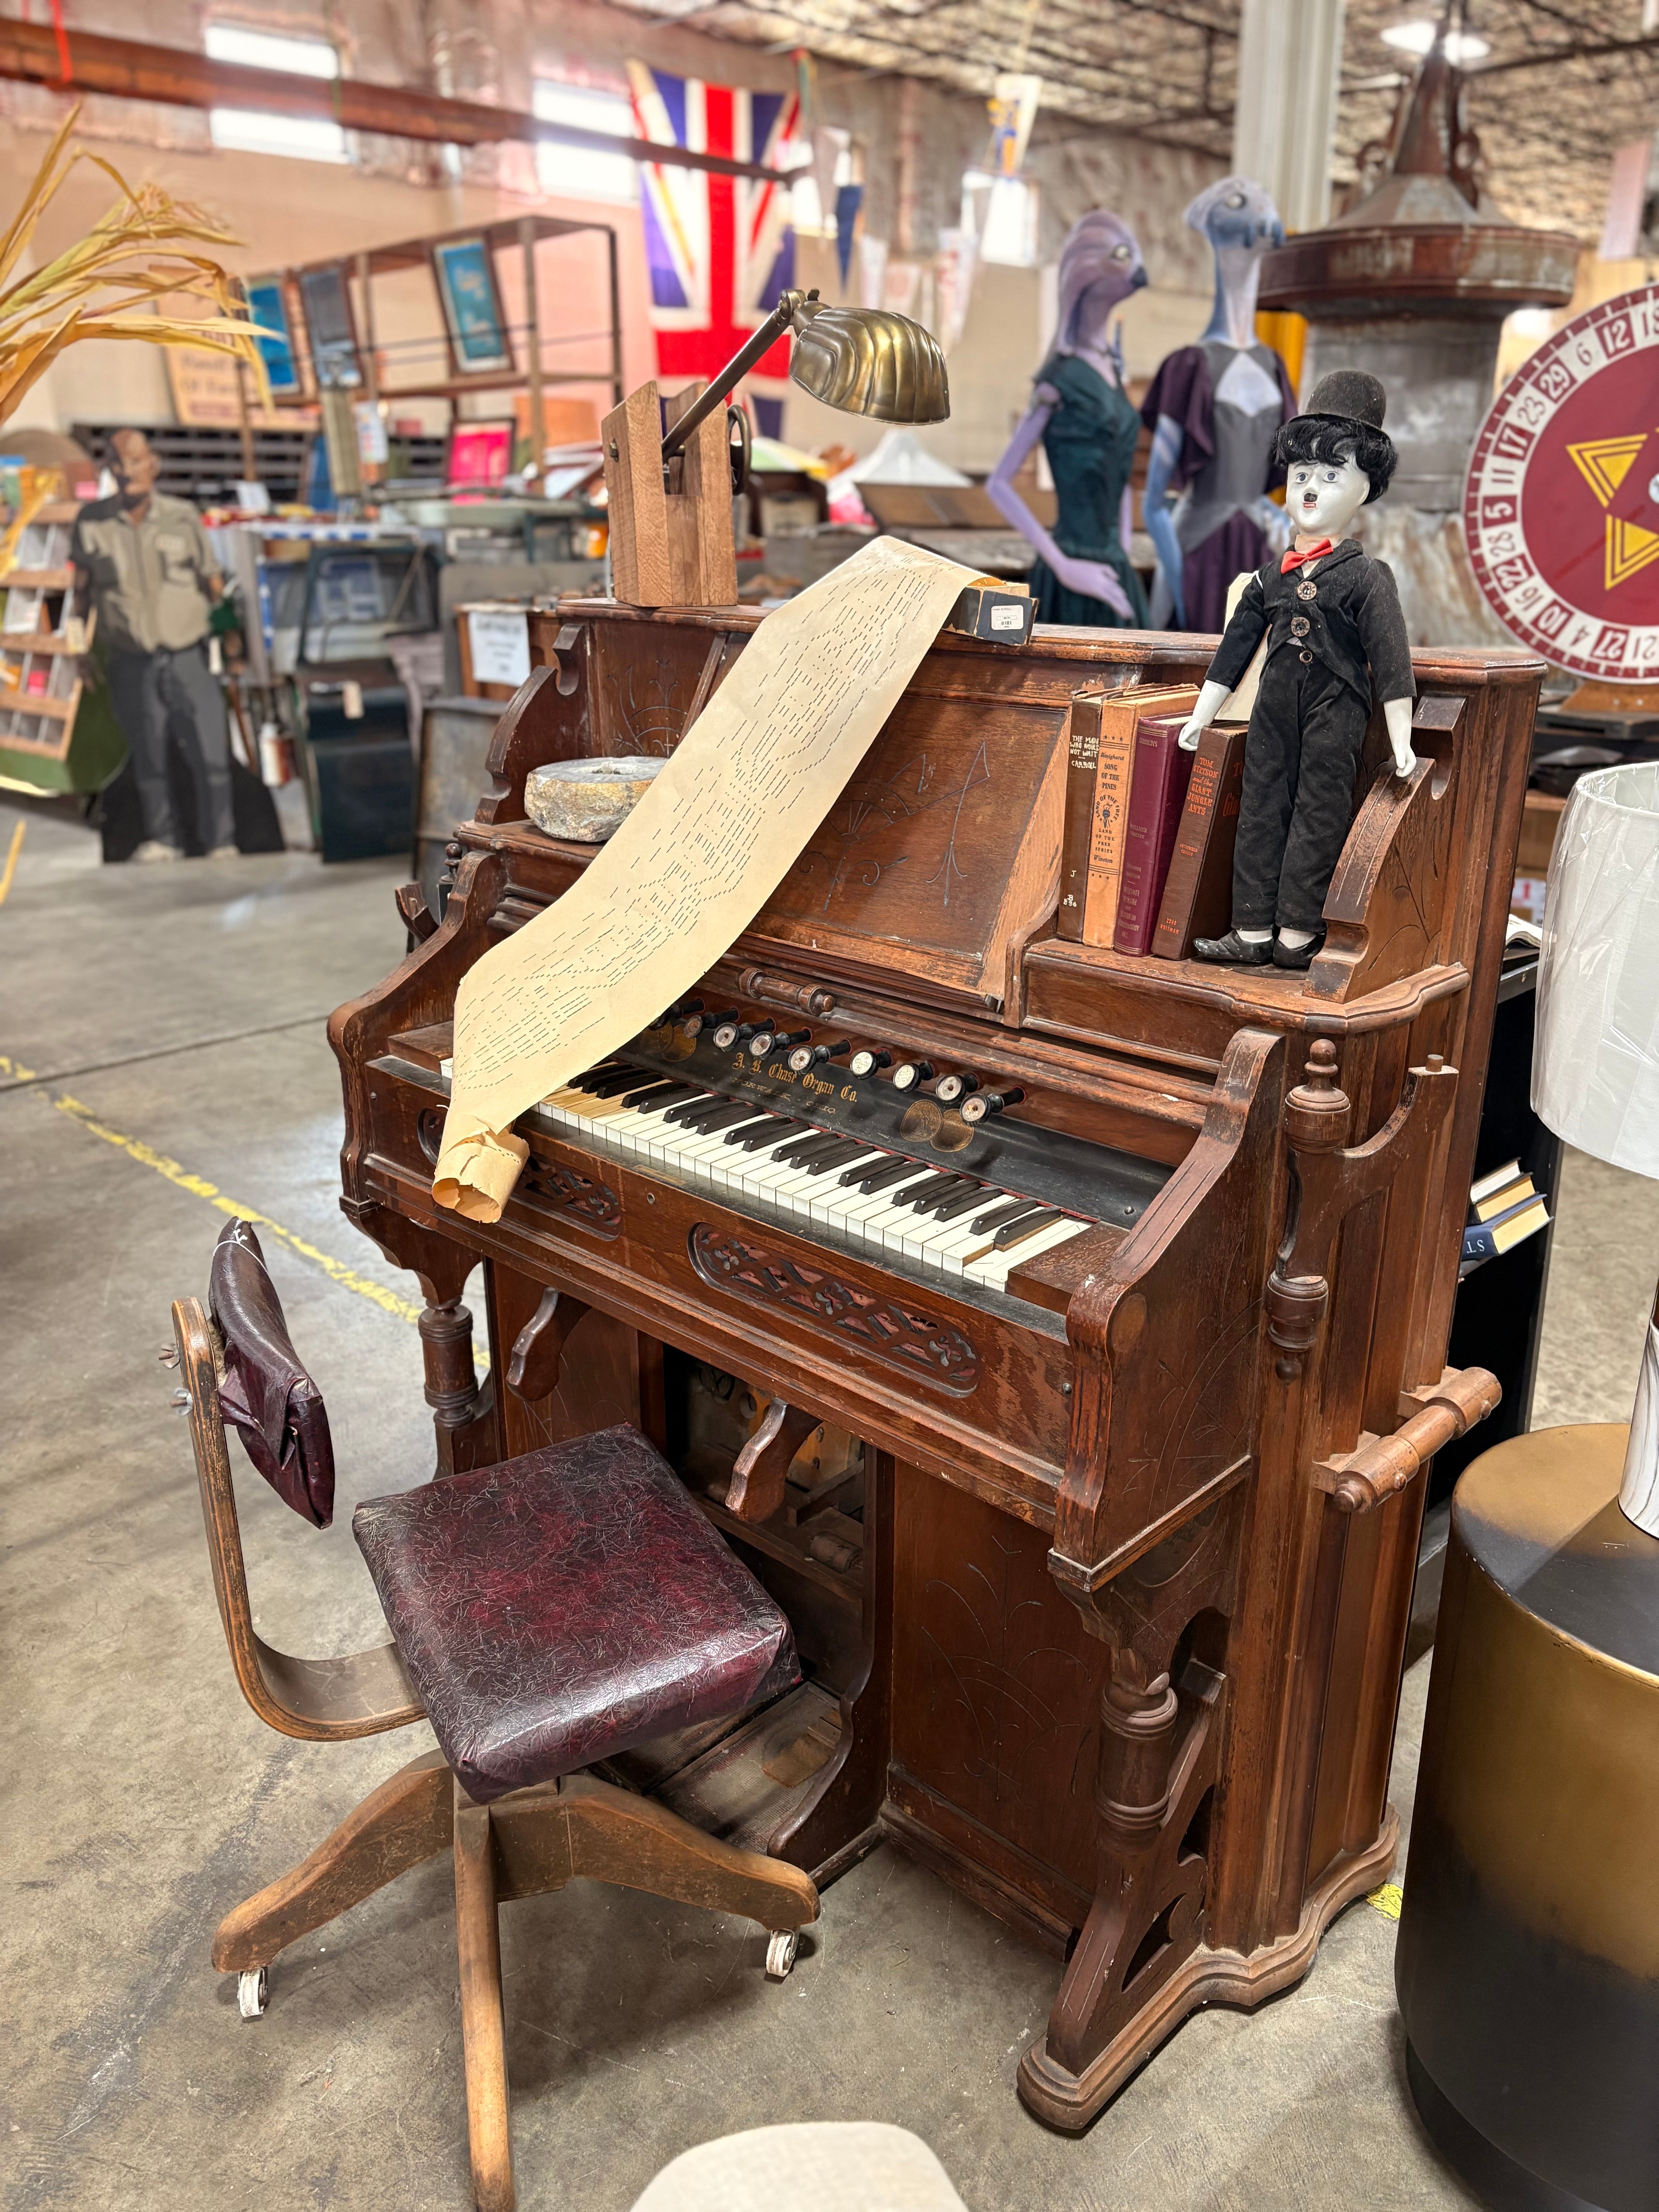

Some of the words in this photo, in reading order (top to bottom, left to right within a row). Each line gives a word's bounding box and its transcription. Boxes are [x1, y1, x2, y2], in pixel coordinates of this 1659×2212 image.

[1602, 319, 1630, 354] 12
[1576, 342, 1592, 366] 6
[1539, 363, 1570, 399] 29
[1517, 397, 1546, 425] 23
[1498, 427, 1528, 456] 17
[1491, 468, 1515, 484] 11
[1484, 501, 1513, 519] 5
[1487, 531, 1516, 557] 28
[1496, 558, 1529, 588] 22
[1515, 587, 1544, 611] 16
[1537, 605, 1569, 635] 10
[1571, 625, 1590, 646] 4
[1593, 630, 1626, 659] 27
[1633, 635, 1658, 659] 21
[1072, 760, 1097, 769] CARROLL
[1192, 764, 1219, 778] STETSON
[1199, 757, 1214, 768] TOM
[1102, 782, 1117, 790] PINES
[1191, 783, 1212, 797] GIANT
[1202, 777, 1213, 787] the
[1107, 795, 1118, 805] THE
[1187, 792, 1213, 807] JUNGLE
[1188, 803, 1206, 816] ANTS
[1093, 855, 1113, 863] Winston
[1160, 924, 1179, 935] WHITMAN
[768, 1063, 797, 1084] Chase
[802, 1072, 835, 1095] Organ
[840, 1085, 857, 1102] Co.
[1467, 1239, 1485, 1254] ST
